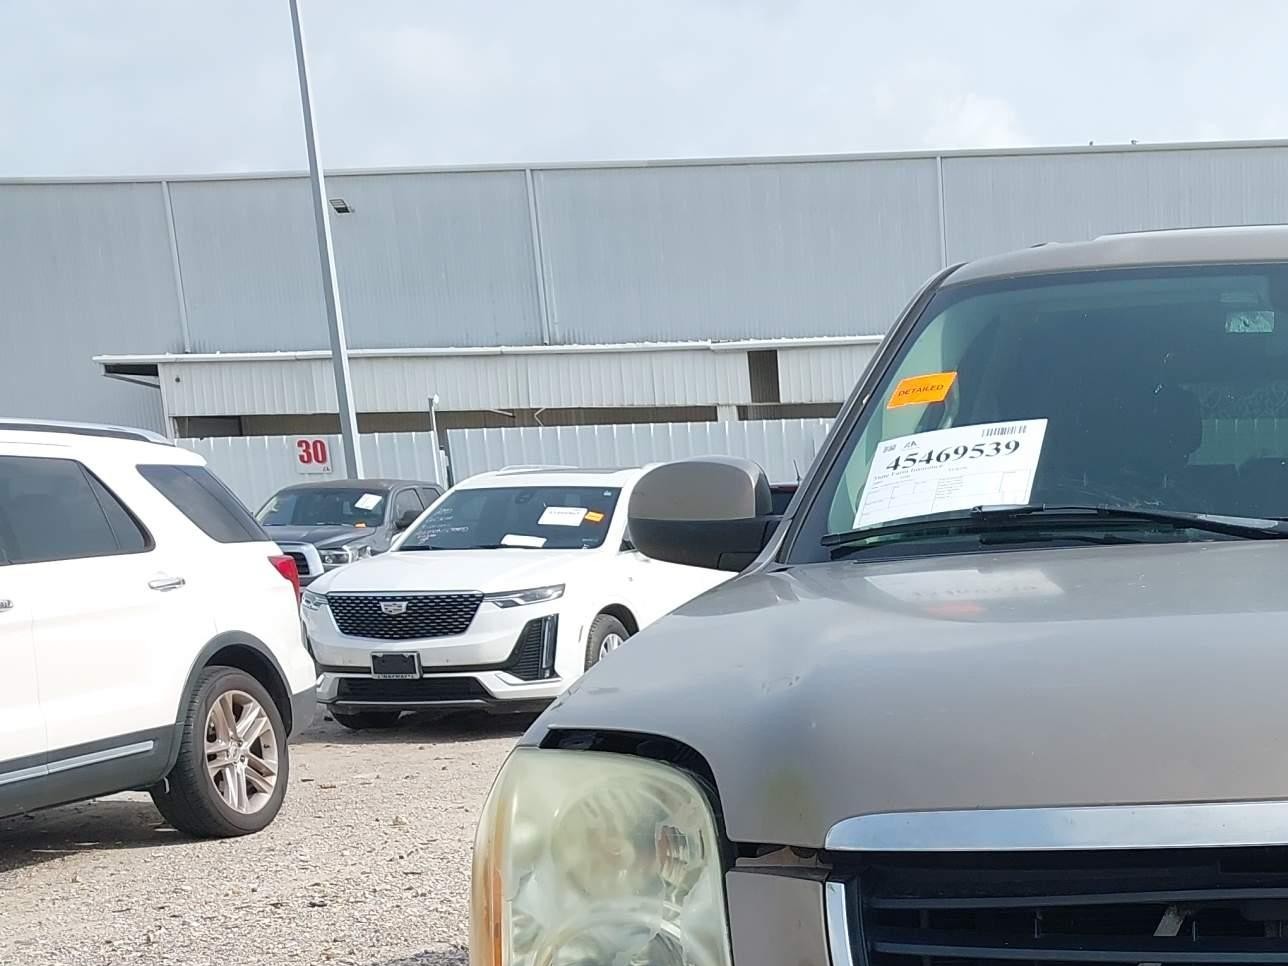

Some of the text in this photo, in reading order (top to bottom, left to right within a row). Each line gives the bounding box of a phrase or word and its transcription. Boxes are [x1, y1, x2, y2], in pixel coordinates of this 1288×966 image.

[898, 384, 944, 396] DETAILED
[297, 439, 328, 464] 30
[886, 440, 1020, 471] 45469539
